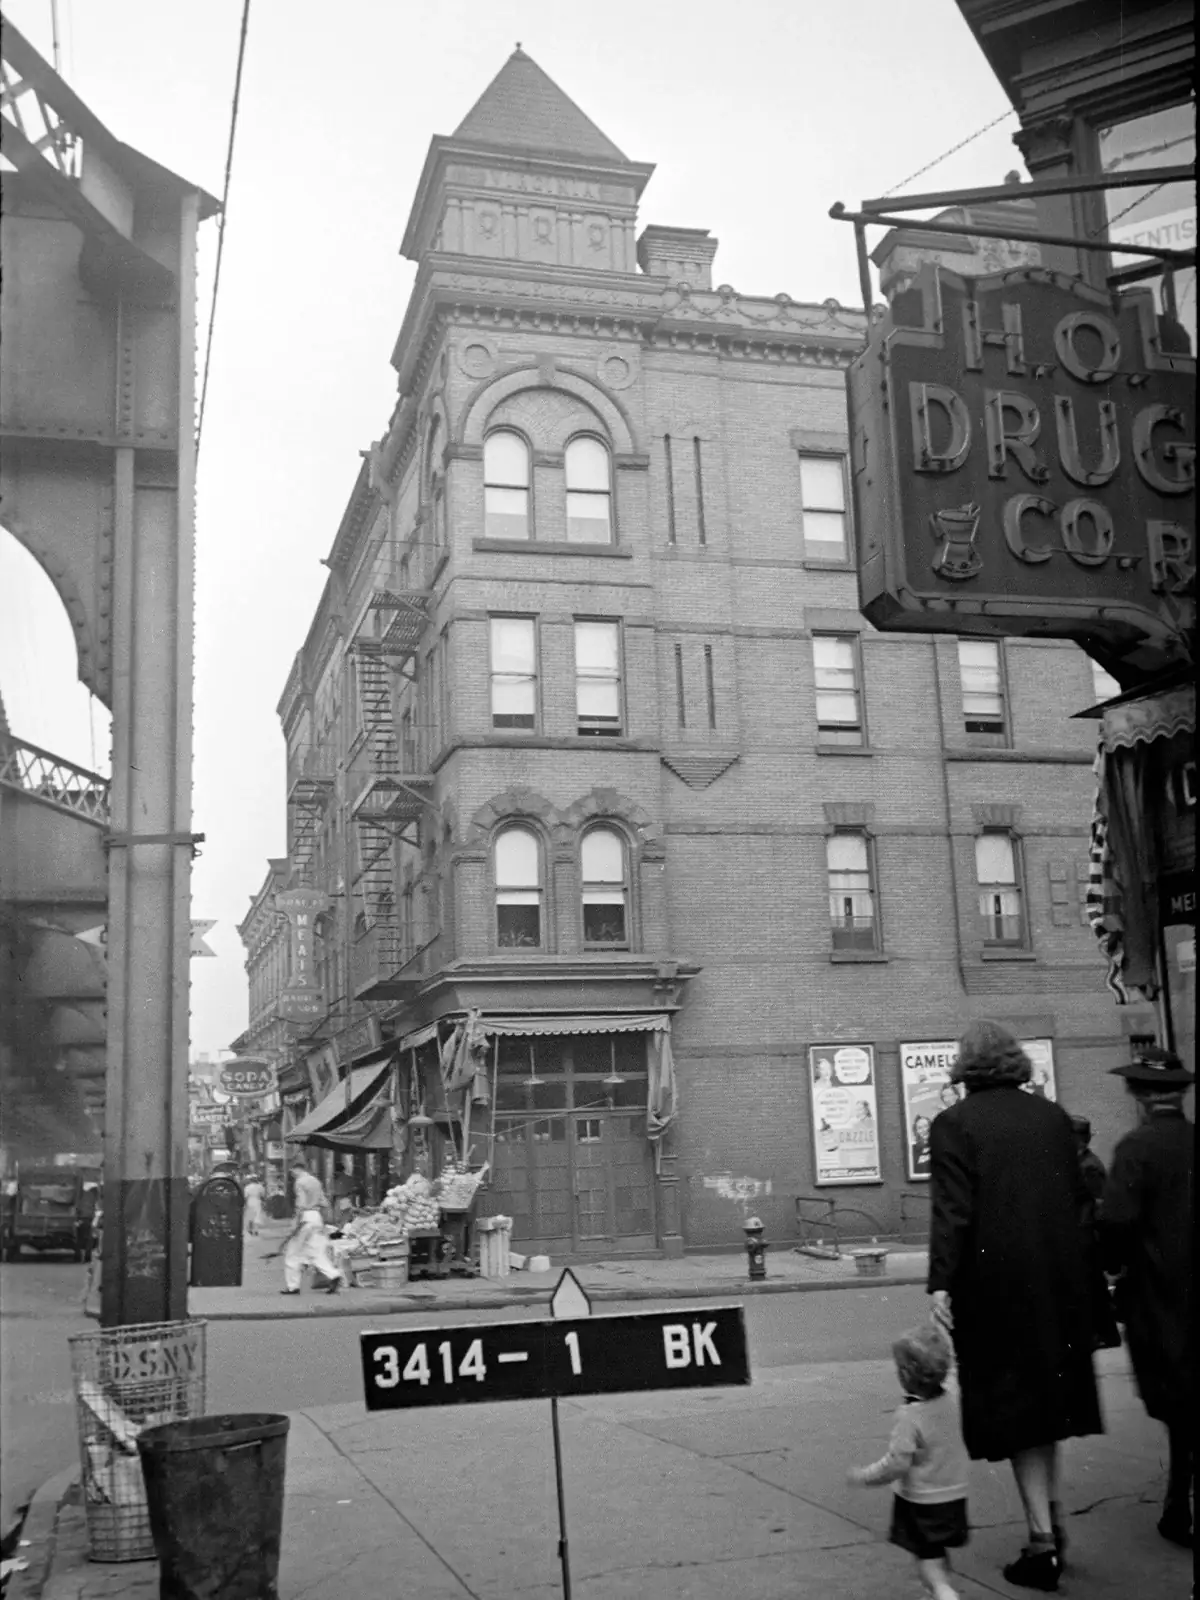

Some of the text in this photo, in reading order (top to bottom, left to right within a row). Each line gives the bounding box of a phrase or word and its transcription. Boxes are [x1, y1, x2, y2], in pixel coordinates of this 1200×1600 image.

[908, 382, 1197, 494] DRUG
[222, 1070, 269, 1082] SODA
[662, 1322, 722, 1369] BK
